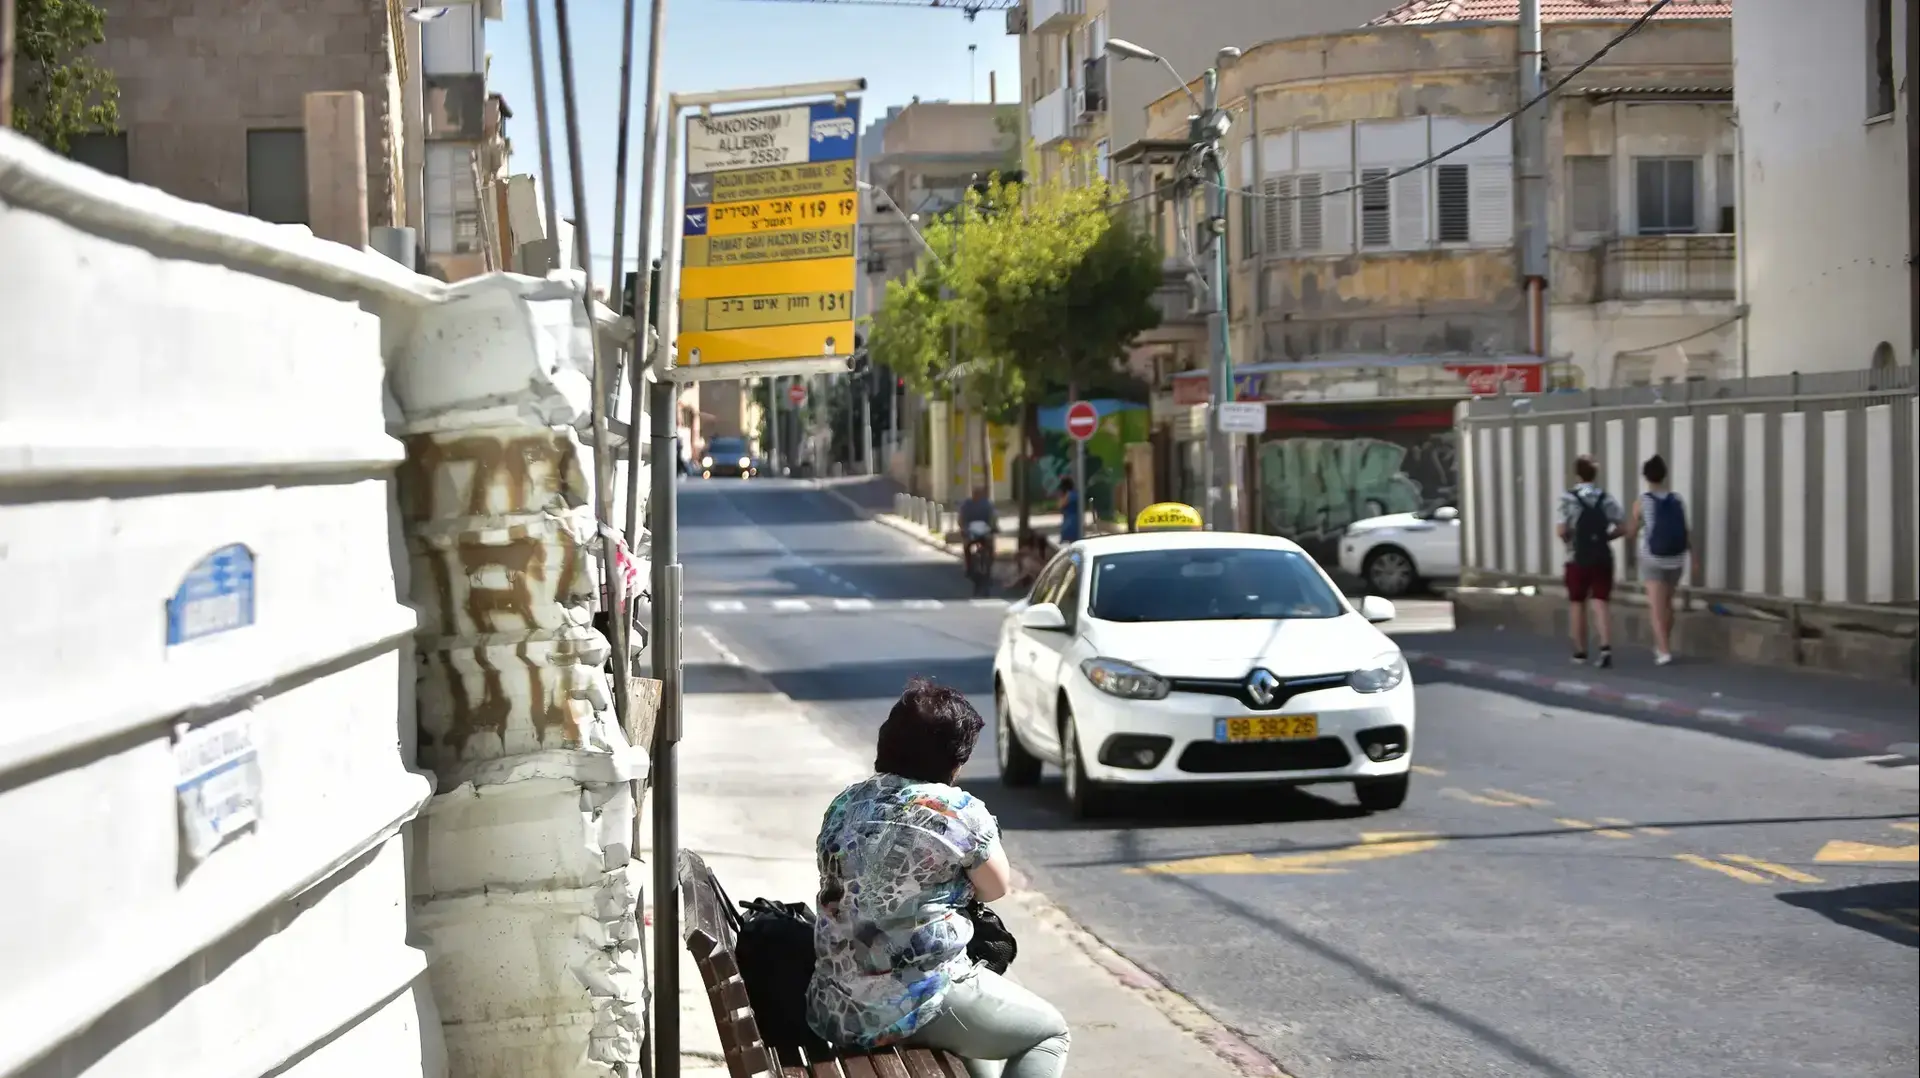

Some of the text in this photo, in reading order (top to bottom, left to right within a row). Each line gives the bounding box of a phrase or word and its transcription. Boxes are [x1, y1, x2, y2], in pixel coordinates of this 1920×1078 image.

[706, 114, 782, 135] HAKOVSHIM
[719, 133, 775, 151] ALLENBY
[749, 147, 789, 164] 25527
[842, 166, 853, 186] 3
[770, 200, 792, 214] אבי
[800, 200, 827, 219] 119
[839, 198, 854, 216] 19
[801, 231, 817, 245] ISH
[832, 231, 849, 250] 31
[753, 297, 779, 311] איש
[819, 293, 845, 311] 131
